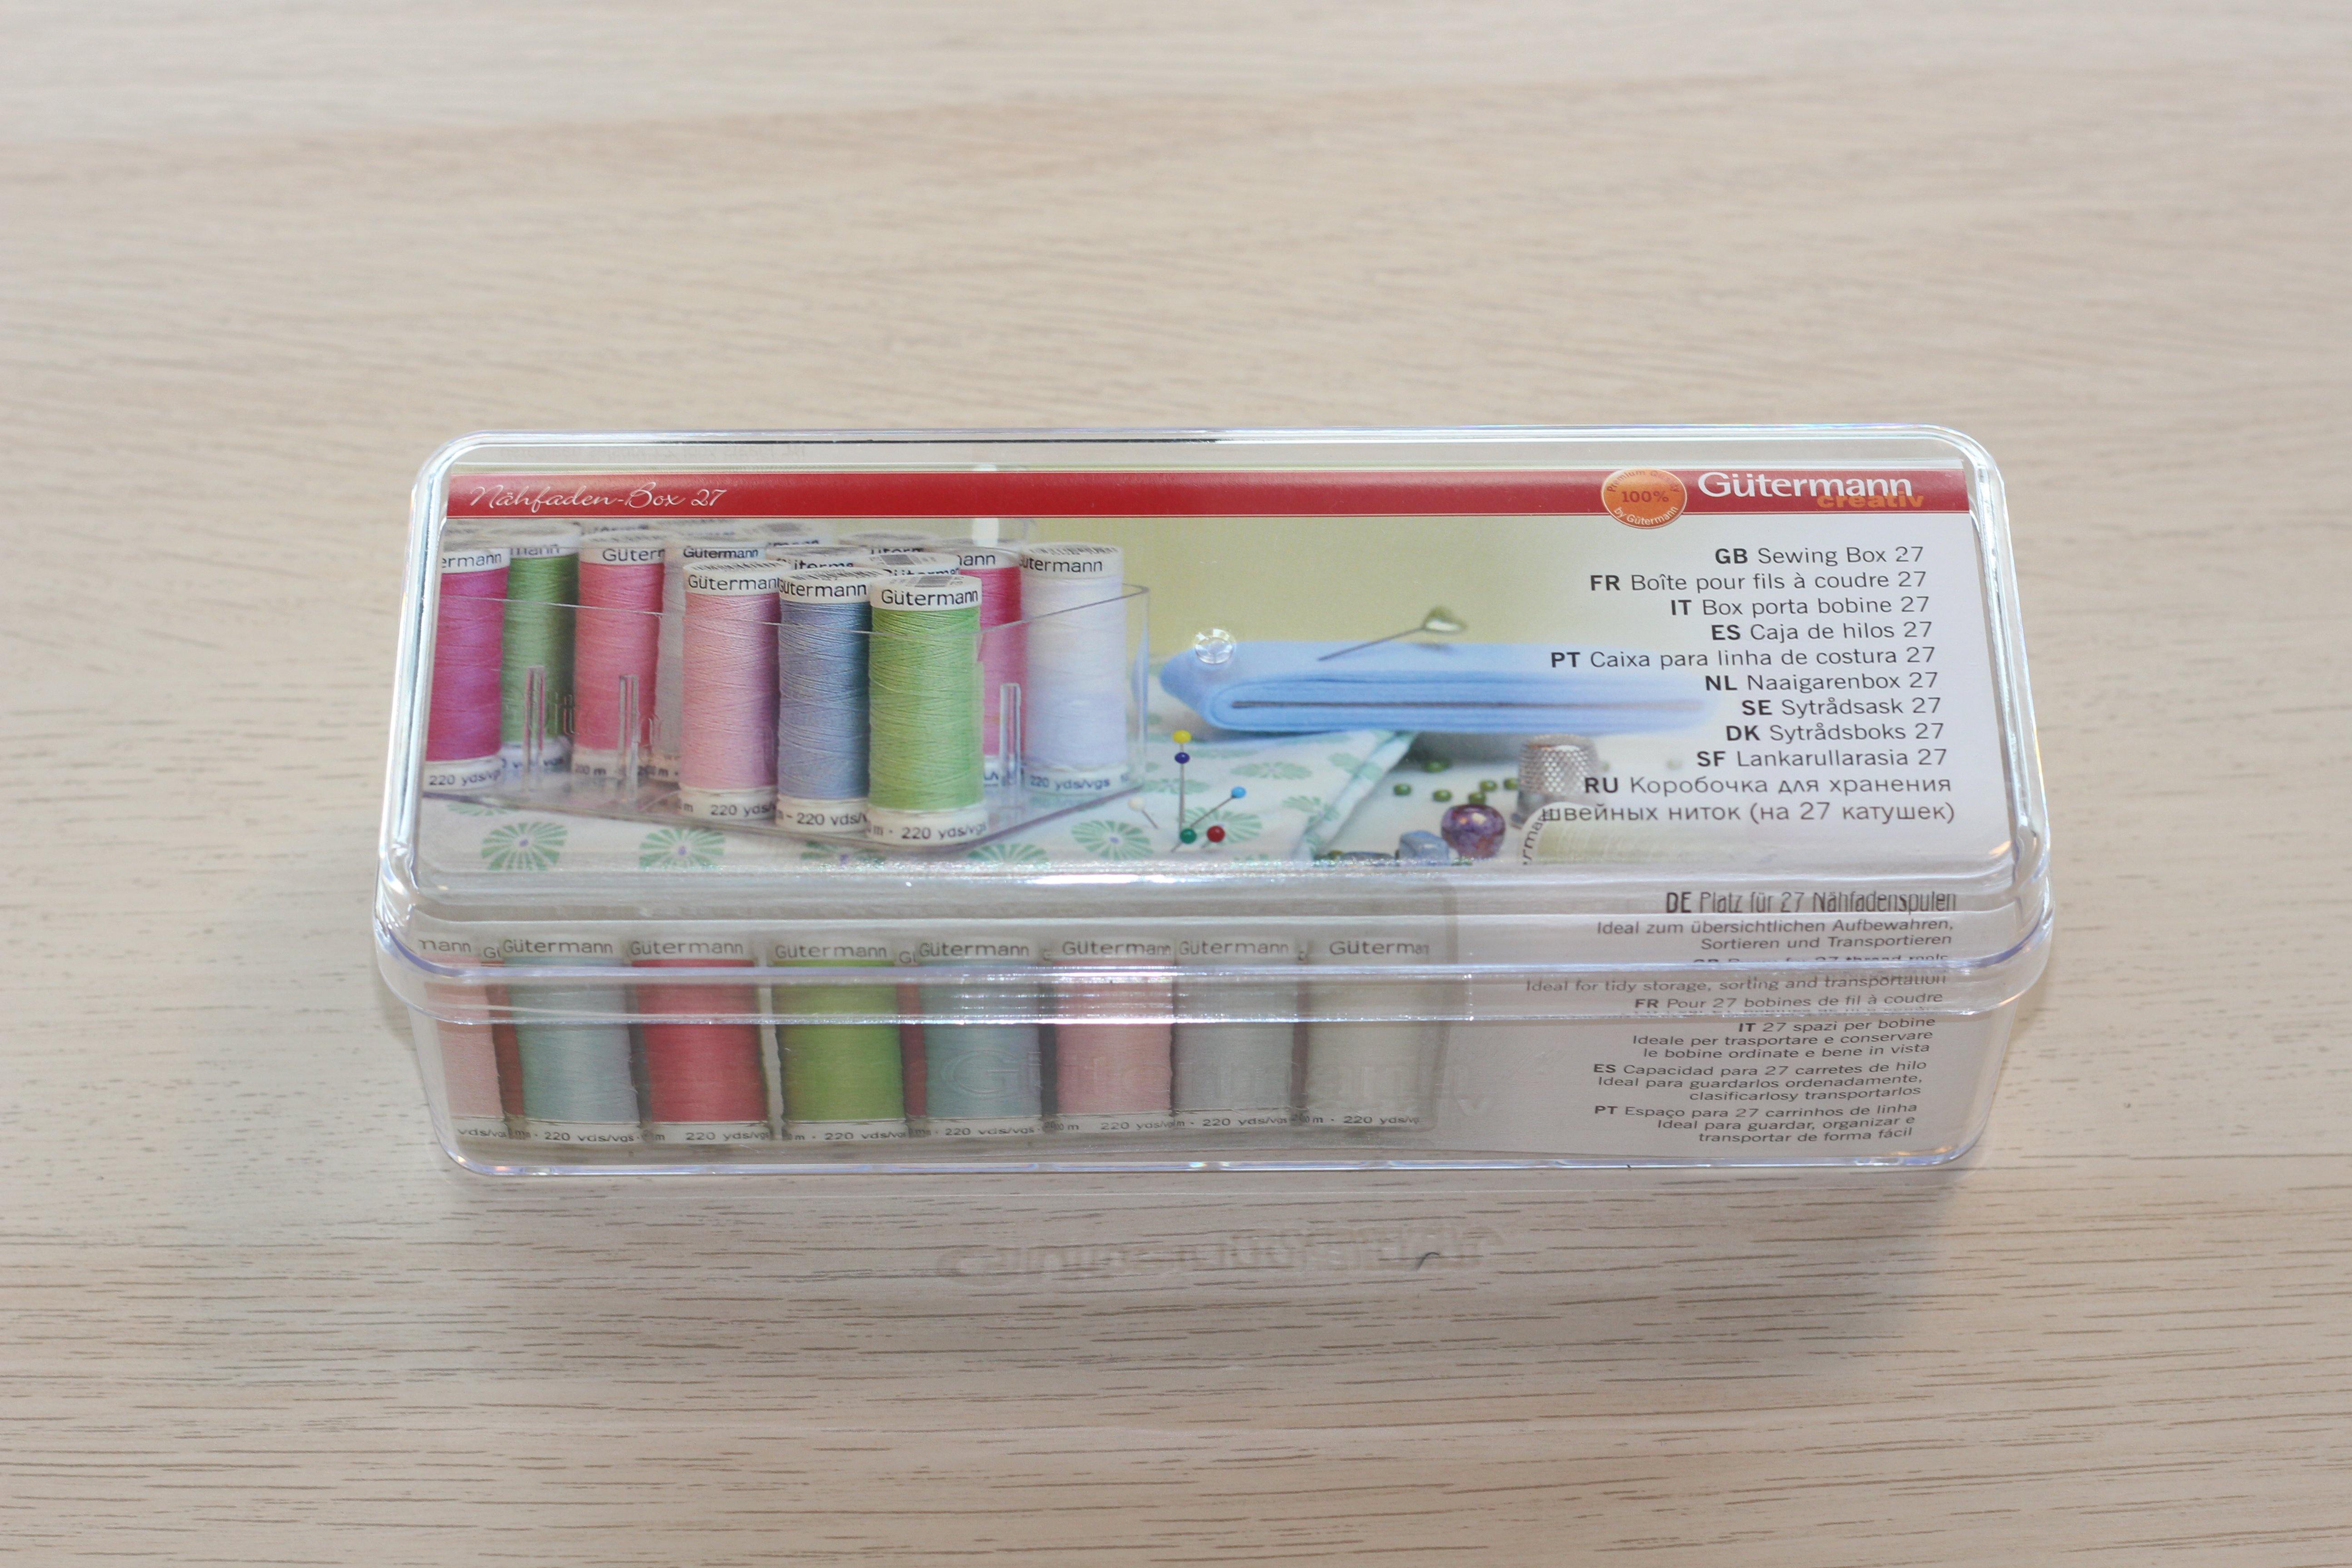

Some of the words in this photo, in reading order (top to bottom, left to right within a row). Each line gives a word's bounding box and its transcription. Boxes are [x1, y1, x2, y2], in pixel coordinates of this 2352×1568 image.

[1698, 472, 1912, 497] Gütermann
[470, 481, 686, 513] Nähfaden-Box
[691, 489, 726, 507] 27
[1622, 490, 1670, 503] 100%
[1817, 491, 1924, 508] creativ
[1613, 506, 1627, 518] by
[1627, 506, 1679, 525] Gütermann
[1715, 548, 1748, 564] GB
[1758, 547, 1838, 567] Sewing
[1846, 547, 1887, 563] Box
[1895, 546, 1924, 562] 27
[1590, 574, 1621, 591] FR
[1631, 573, 1687, 591] Boîte
[1696, 577, 1746, 594] pour
[1752, 573, 1785, 589] fils
[1793, 572, 1806, 589] à
[1814, 572, 1890, 588] coudre
[1897, 571, 1926, 587] 27
[882, 589, 978, 606] Gütermann
[1671, 599, 1692, 616] IT
[1702, 599, 1744, 616] Box
[1752, 598, 1808, 619] porta
[1818, 597, 1892, 614] bobine
[1901, 596, 1929, 612] 27
[1711, 624, 1741, 641] ES
[1750, 623, 1799, 644] Caja
[1808, 623, 1834, 639] de
[1843, 622, 1895, 639] hilos
[1903, 621, 1932, 637] 27
[1551, 652, 1581, 668] PT
[1590, 651, 1650, 668] Caixa
[1660, 654, 1708, 671] para
[1718, 649, 1772, 666] linha
[1781, 649, 1808, 665] de
[1816, 648, 1897, 665] costura
[1906, 646, 1936, 663] 27
[1705, 675, 1738, 691] NL
[1747, 673, 1901, 694] Naaigarenbox
[1909, 671, 1938, 688] 27
[1741, 699, 1773, 716] SE
[1781, 696, 1904, 719] Sytrådsask
[1911, 697, 1941, 714] 27
[1725, 725, 1761, 741] DK
[1769, 722, 1906, 745] Sytrådsboks
[1915, 722, 1944, 740] 27
[1696, 750, 1726, 768] SF
[1737, 749, 1908, 767] Lankarullarasia
[1917, 748, 1947, 765] 27
[429, 774, 456, 785] 220
[1584, 777, 1619, 794] RU
[1630, 775, 1768, 797] Коробочка
[1778, 779, 1819, 794] для
[1829, 779, 1951, 796] хранения
[710, 804, 738, 816] 220
[1542, 802, 1659, 822] швейных
[1669, 807, 1741, 820] ниток
[1749, 802, 1789, 824] (на
[1800, 801, 1830, 820] 27
[1842, 802, 1955, 825] катушек)
[797, 812, 825, 826] 220
[902, 826, 931, 839] 220
[1665, 891, 1692, 914] DE
[1699, 892, 1743, 913] Platz
[1750, 892, 1772, 913] für
[1780, 892, 1804, 913] 27
[1597, 922, 1639, 934] Ideal
[1646, 924, 1683, 934] zum
[1691, 921, 1825, 933] übersichtlichen
[1832, 919, 1953, 931] Aufbewahren,
[504, 939, 613, 954] Gütermann
[631, 940, 743, 955] Gütermann
[919, 941, 1029, 956] Gütermann
[1180, 940, 1289, 955] Gütermann
[1701, 938, 1779, 950] Sortieren
[1787, 937, 1820, 948] und
[1828, 936, 1952, 949] Transportieren
[775, 944, 887, 959] Gütermann
[1526, 980, 1568, 992] Ideal
[1575, 979, 1599, 992] for
[1604, 980, 1637, 994] tidy
[1642, 981, 1712, 993] storage,
[1719, 975, 1779, 991] sorting
[1785, 975, 1818, 990] and
[1635, 999, 1659, 1008] FR
[1667, 999, 1706, 1008] Pour
[1713, 998, 1737, 1008] 27
[1744, 997, 1811, 1007] bobines
[1818, 996, 1839, 1006] de
[1845, 995, 1861, 1005] fil
[1867, 994, 1878, 1005] à
[1884, 993, 1943, 1004] coudre
[1739, 1023, 1756, 1032] IT
[1763, 1022, 1787, 1032] 27
[1793, 1021, 1837, 1034] spazi
[1844, 1022, 1872, 1032] per
[1878, 1018, 1936, 1029] bobine
[1633, 1035, 1684, 1045] Ideale
[1691, 1038, 1719, 1047] per
[1725, 1036, 1818, 1047] trasportare
[1840, 1032, 1933, 1044] conservare
[1644, 1048, 1658, 1058] le
[1665, 1049, 1722, 1058] bobine
[1729, 1049, 1799, 1058] ordinate
[1822, 1048, 1862, 1057] bene
[1869, 1045, 1884, 1056] in
[1891, 1044, 1930, 1054] vista
[1593, 1063, 1616, 1073] ES
[1623, 1065, 1714, 1077] Capacidad
[1720, 1068, 1758, 1078] para
[1764, 1066, 1788, 1075] 27
[1795, 1065, 1862, 1075] carretes
[1869, 1063, 1889, 1073] de
[1896, 1060, 1926, 1071] hilo
[1599, 1077, 1639, 1086] Ideal
[1646, 1080, 1683, 1089] para
[1689, 1079, 1779, 1090] guardarlos
[1785, 1074, 1922, 1088] ordenadamente,
[1690, 1091, 1798, 1102] clasificarlosy
[1805, 1087, 1921, 1101] transportarlos
[1594, 1105, 1618, 1115] PT
[1625, 1106, 1685, 1119] Espaço
[1692, 1110, 1728, 1119] para
[1735, 1108, 1759, 1117] 27
[1765, 1107, 1843, 1117] carrinhos
[1850, 1107, 1870, 1115] de
[1877, 1104, 1917, 1114] linha
[1658, 1119, 1698, 1129] Ideal
[1705, 1122, 1741, 1131] para
[1747, 1121, 1815, 1132] guardar,
[1823, 1117, 1900, 1130] organizar
[545, 1132, 570, 1141] 220
[1699, 1133, 1792, 1144] transportar
[1797, 1133, 1818, 1142] de
[1824, 1132, 1872, 1141] forma
[1878, 1127, 1912, 1138] fácil
